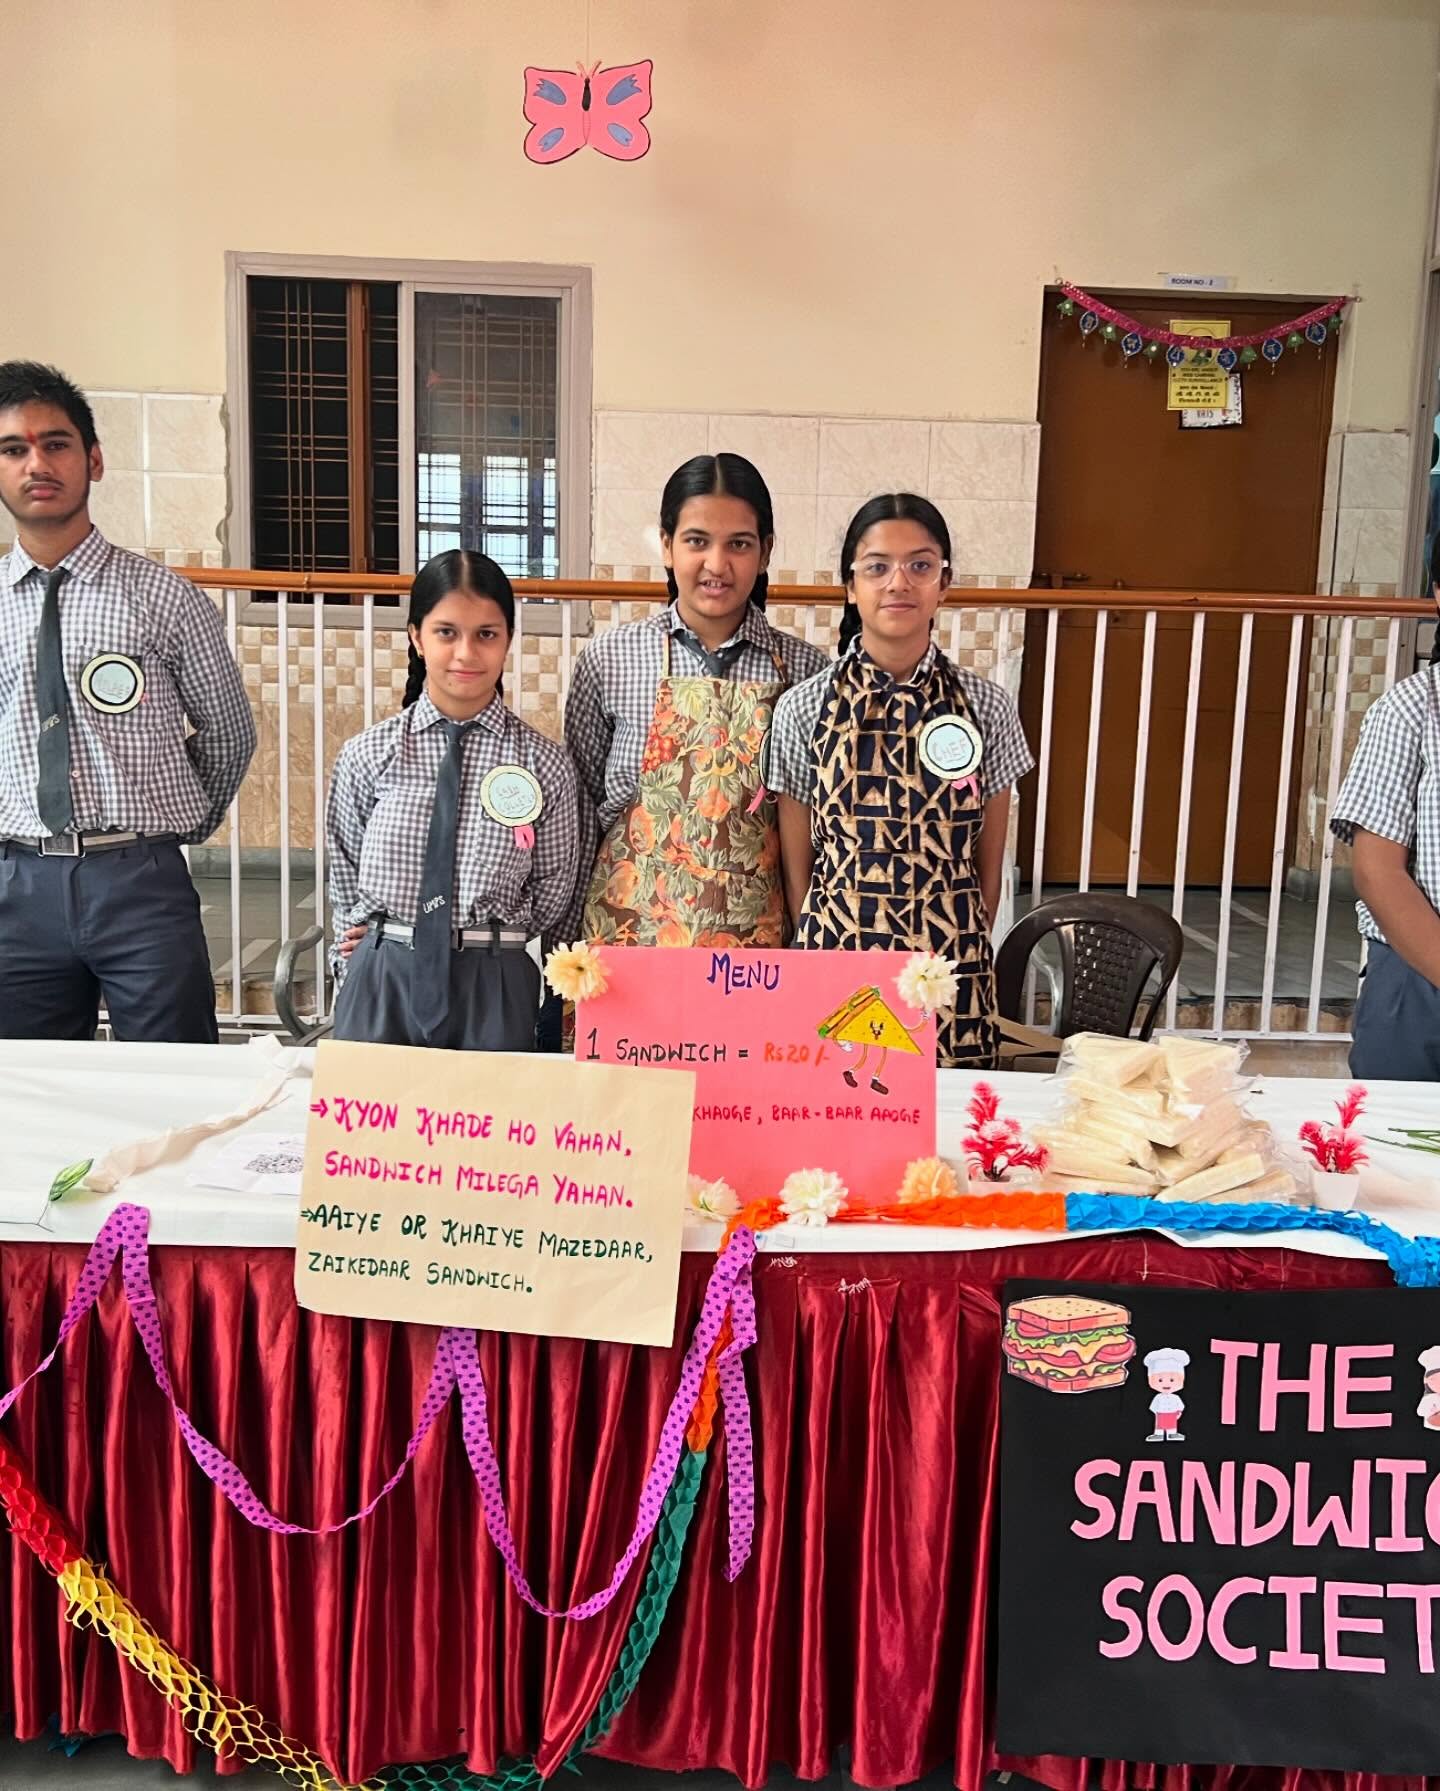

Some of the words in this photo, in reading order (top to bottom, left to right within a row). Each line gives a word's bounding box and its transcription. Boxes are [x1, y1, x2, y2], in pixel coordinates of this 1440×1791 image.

[707, 952, 781, 995] MENU
[587, 1028, 600, 1059] 1
[617, 1039, 726, 1066] SANDWICH
[334, 1098, 397, 1132] KYON
[417, 1108, 492, 1145] KHADE
[509, 1122, 535, 1145] HO
[871, 1107, 920, 1124] AAOGE
[326, 1151, 441, 1184] SANDWICH
[457, 1166, 538, 1198] MILEGA
[553, 1175, 632, 1207] YAHAN.
[314, 1204, 381, 1234] AAIYE
[402, 1215, 426, 1239] OR
[442, 1219, 523, 1248] KHAIYE
[539, 1232, 652, 1262] MAZEDAAR,
[309, 1252, 410, 1280] ZAIKEDAAR
[427, 1263, 532, 1292] SANDWICH.
[1211, 1339, 1393, 1432] THE
[1071, 1459, 1440, 1552] SANDWI
